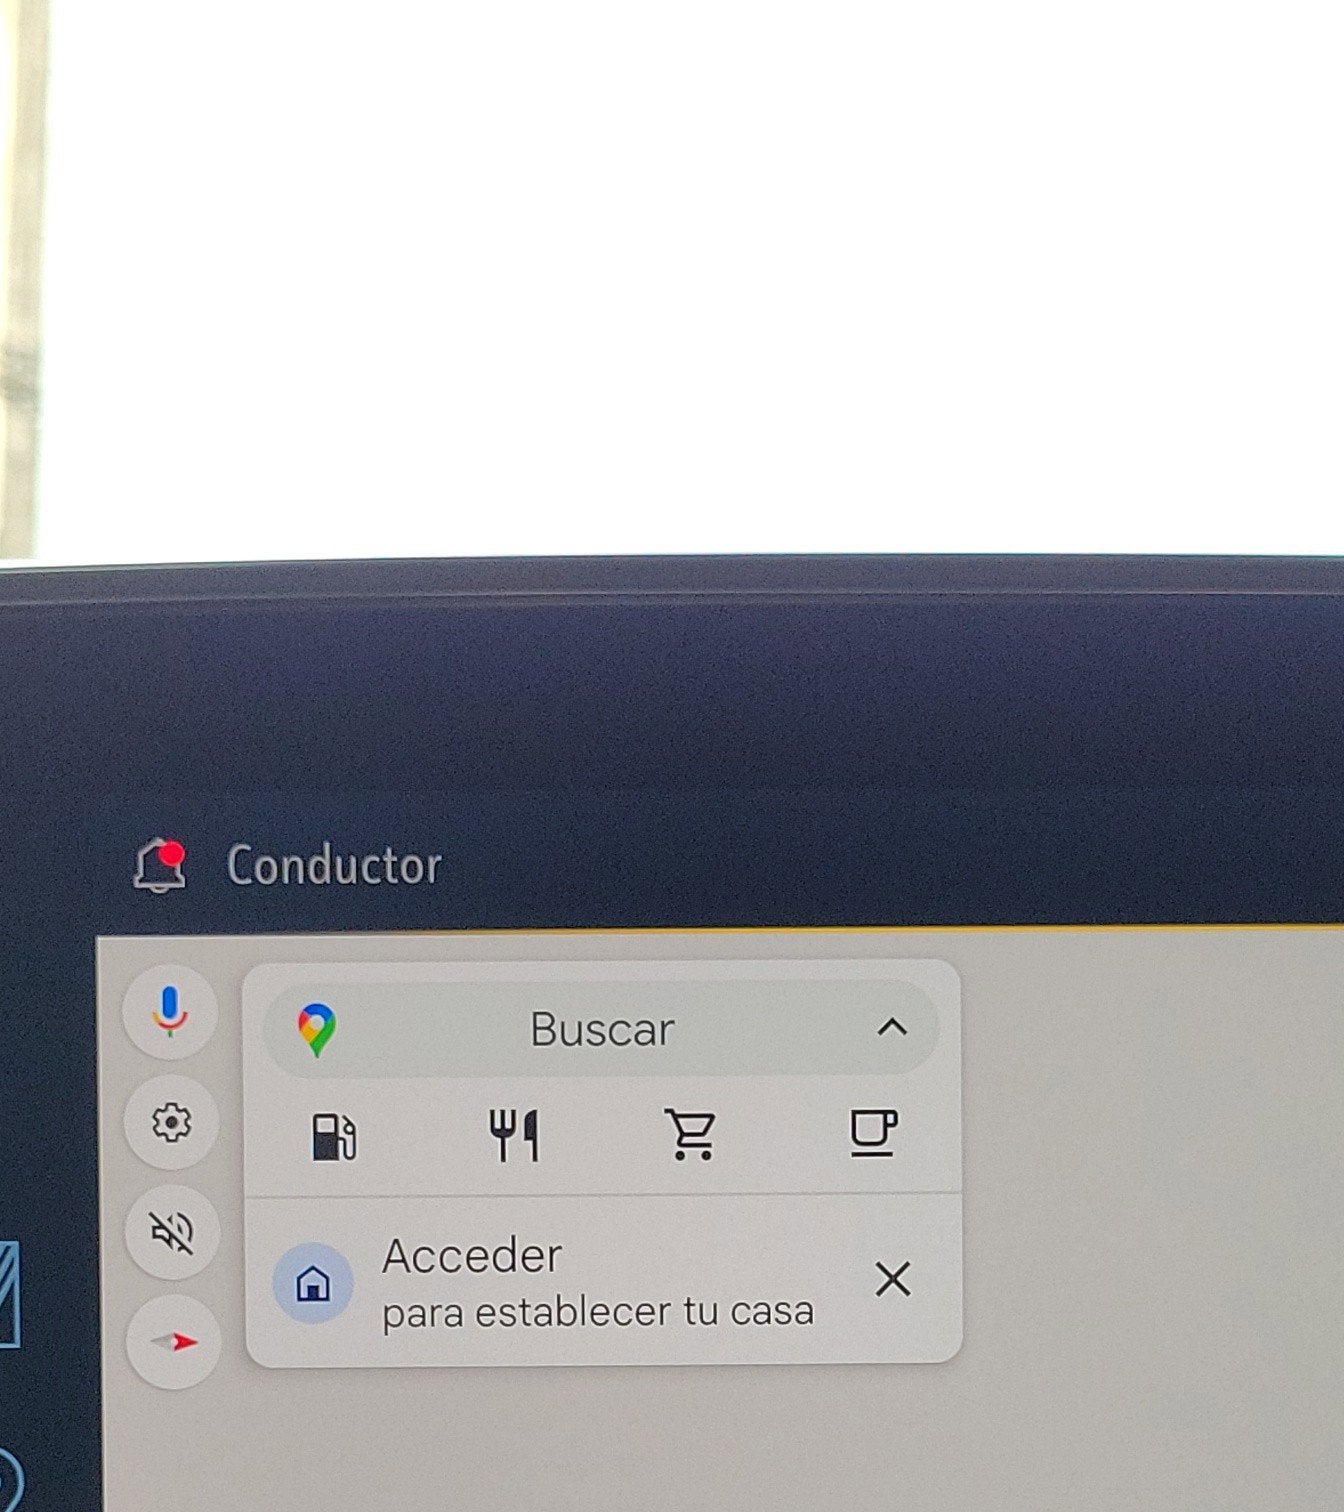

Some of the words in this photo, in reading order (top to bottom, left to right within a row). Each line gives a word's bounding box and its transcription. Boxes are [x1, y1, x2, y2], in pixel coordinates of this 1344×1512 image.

[227, 840, 443, 885] Conductor
[532, 1010, 676, 1048] Buscar
[382, 1234, 563, 1274] Acceder
[383, 1303, 464, 1337] para
[475, 1293, 672, 1328] establecer
[683, 1296, 718, 1326] tu
[730, 1300, 814, 1326] casa
